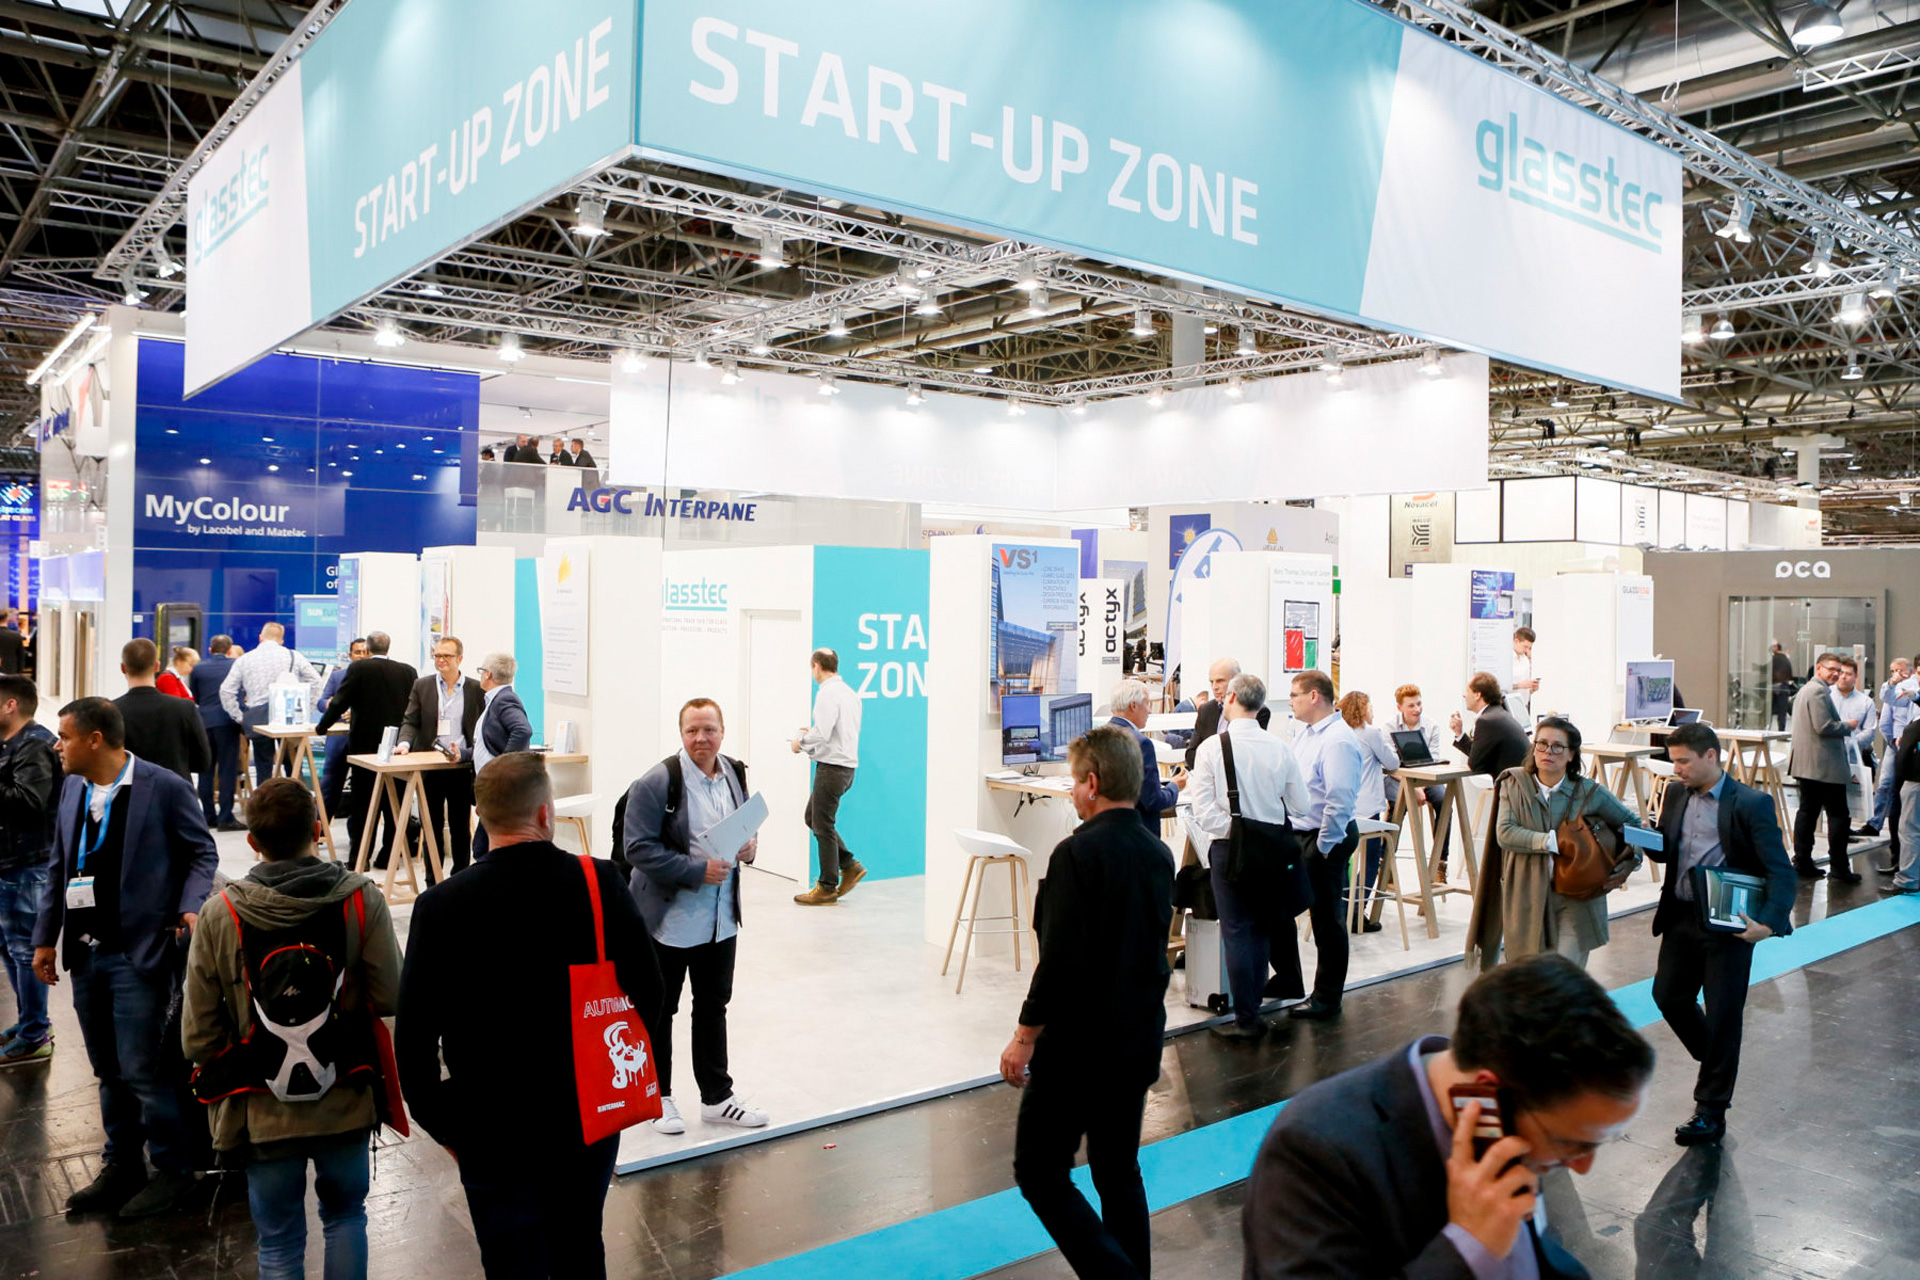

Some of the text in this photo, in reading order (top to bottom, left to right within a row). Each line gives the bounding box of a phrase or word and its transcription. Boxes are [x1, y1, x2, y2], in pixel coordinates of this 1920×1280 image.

[354, 16, 612, 259] START-UP ZONE
[688, 16, 1259, 246] START-UP ZONE
[1476, 111, 1663, 241] glasstec
[194, 144, 269, 264] glasstec
[145, 494, 290, 525] MyColour
[567, 487, 757, 521] AGC INTERPANE
[187, 524, 306, 537] by Lacobel and Matelac
[326, 566, 338, 576] Gl
[662, 577, 728, 605] lasstec
[858, 613, 927, 650] STA
[1105, 587, 1120, 653] actyx
[857, 661, 929, 698] ZON
